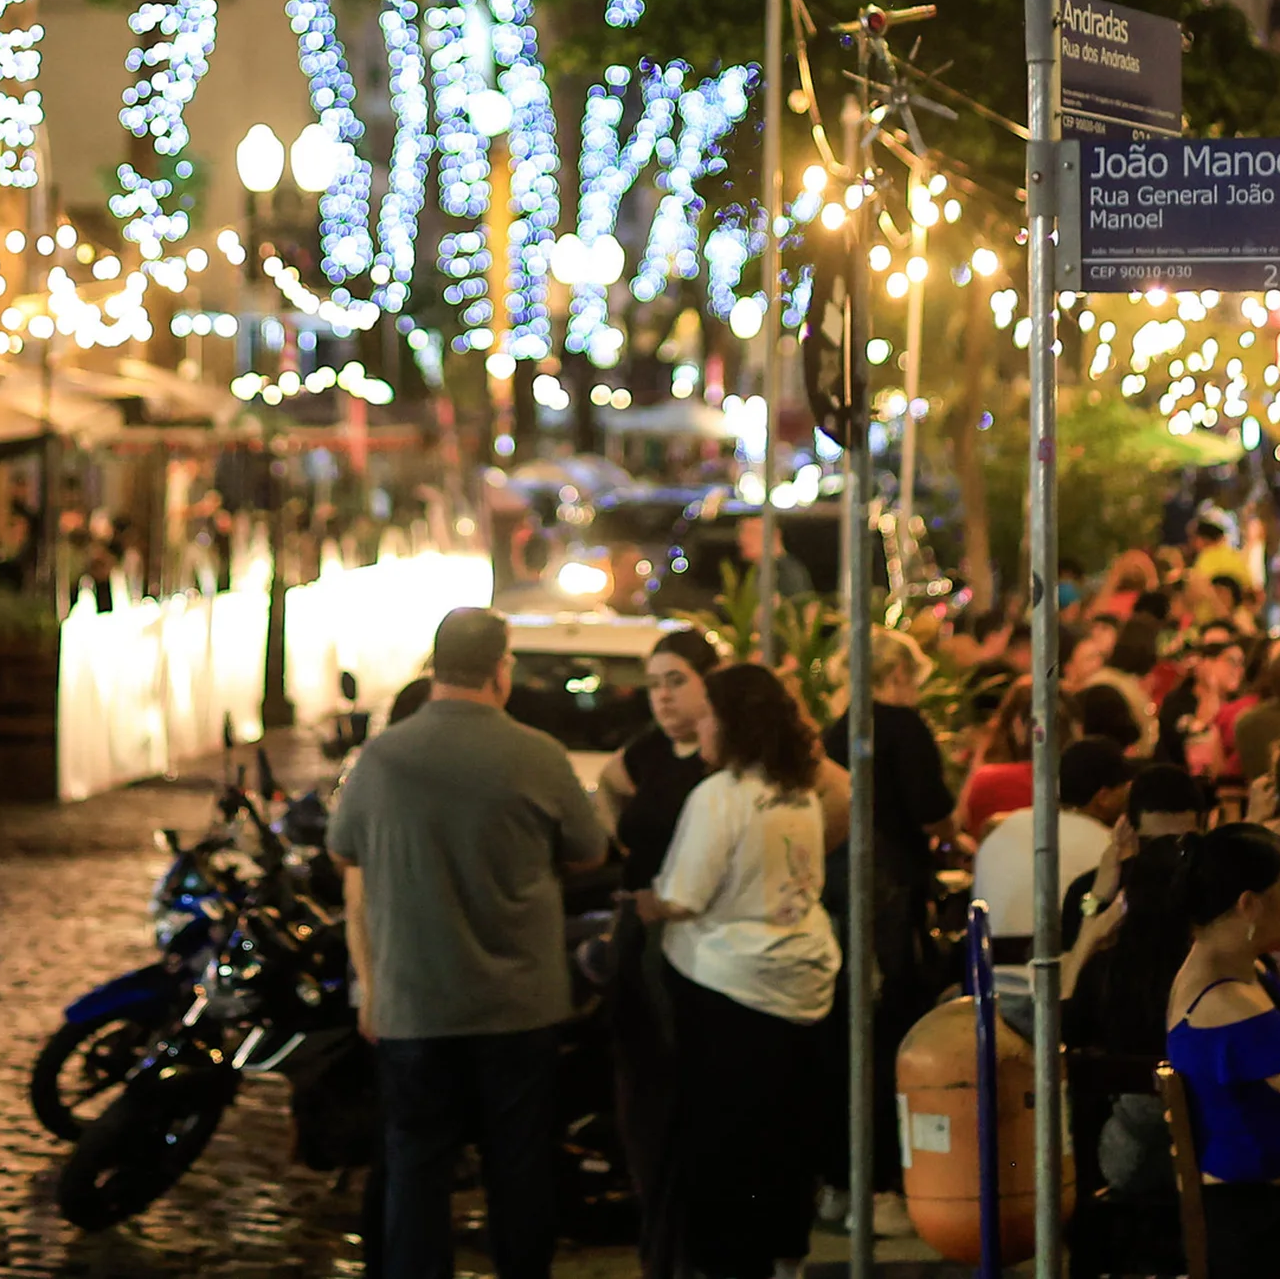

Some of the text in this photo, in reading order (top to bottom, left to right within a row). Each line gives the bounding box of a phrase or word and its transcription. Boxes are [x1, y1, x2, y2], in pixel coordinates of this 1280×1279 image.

[1062, 0, 1129, 44] Andradas
[1062, 36, 1141, 73] Rua dos Andradas
[1090, 144, 1169, 179] João
[1090, 182, 1275, 206] Rua General João
[1090, 208, 1163, 229] Manoel
[1090, 265, 1192, 280] CEP 90010-030
